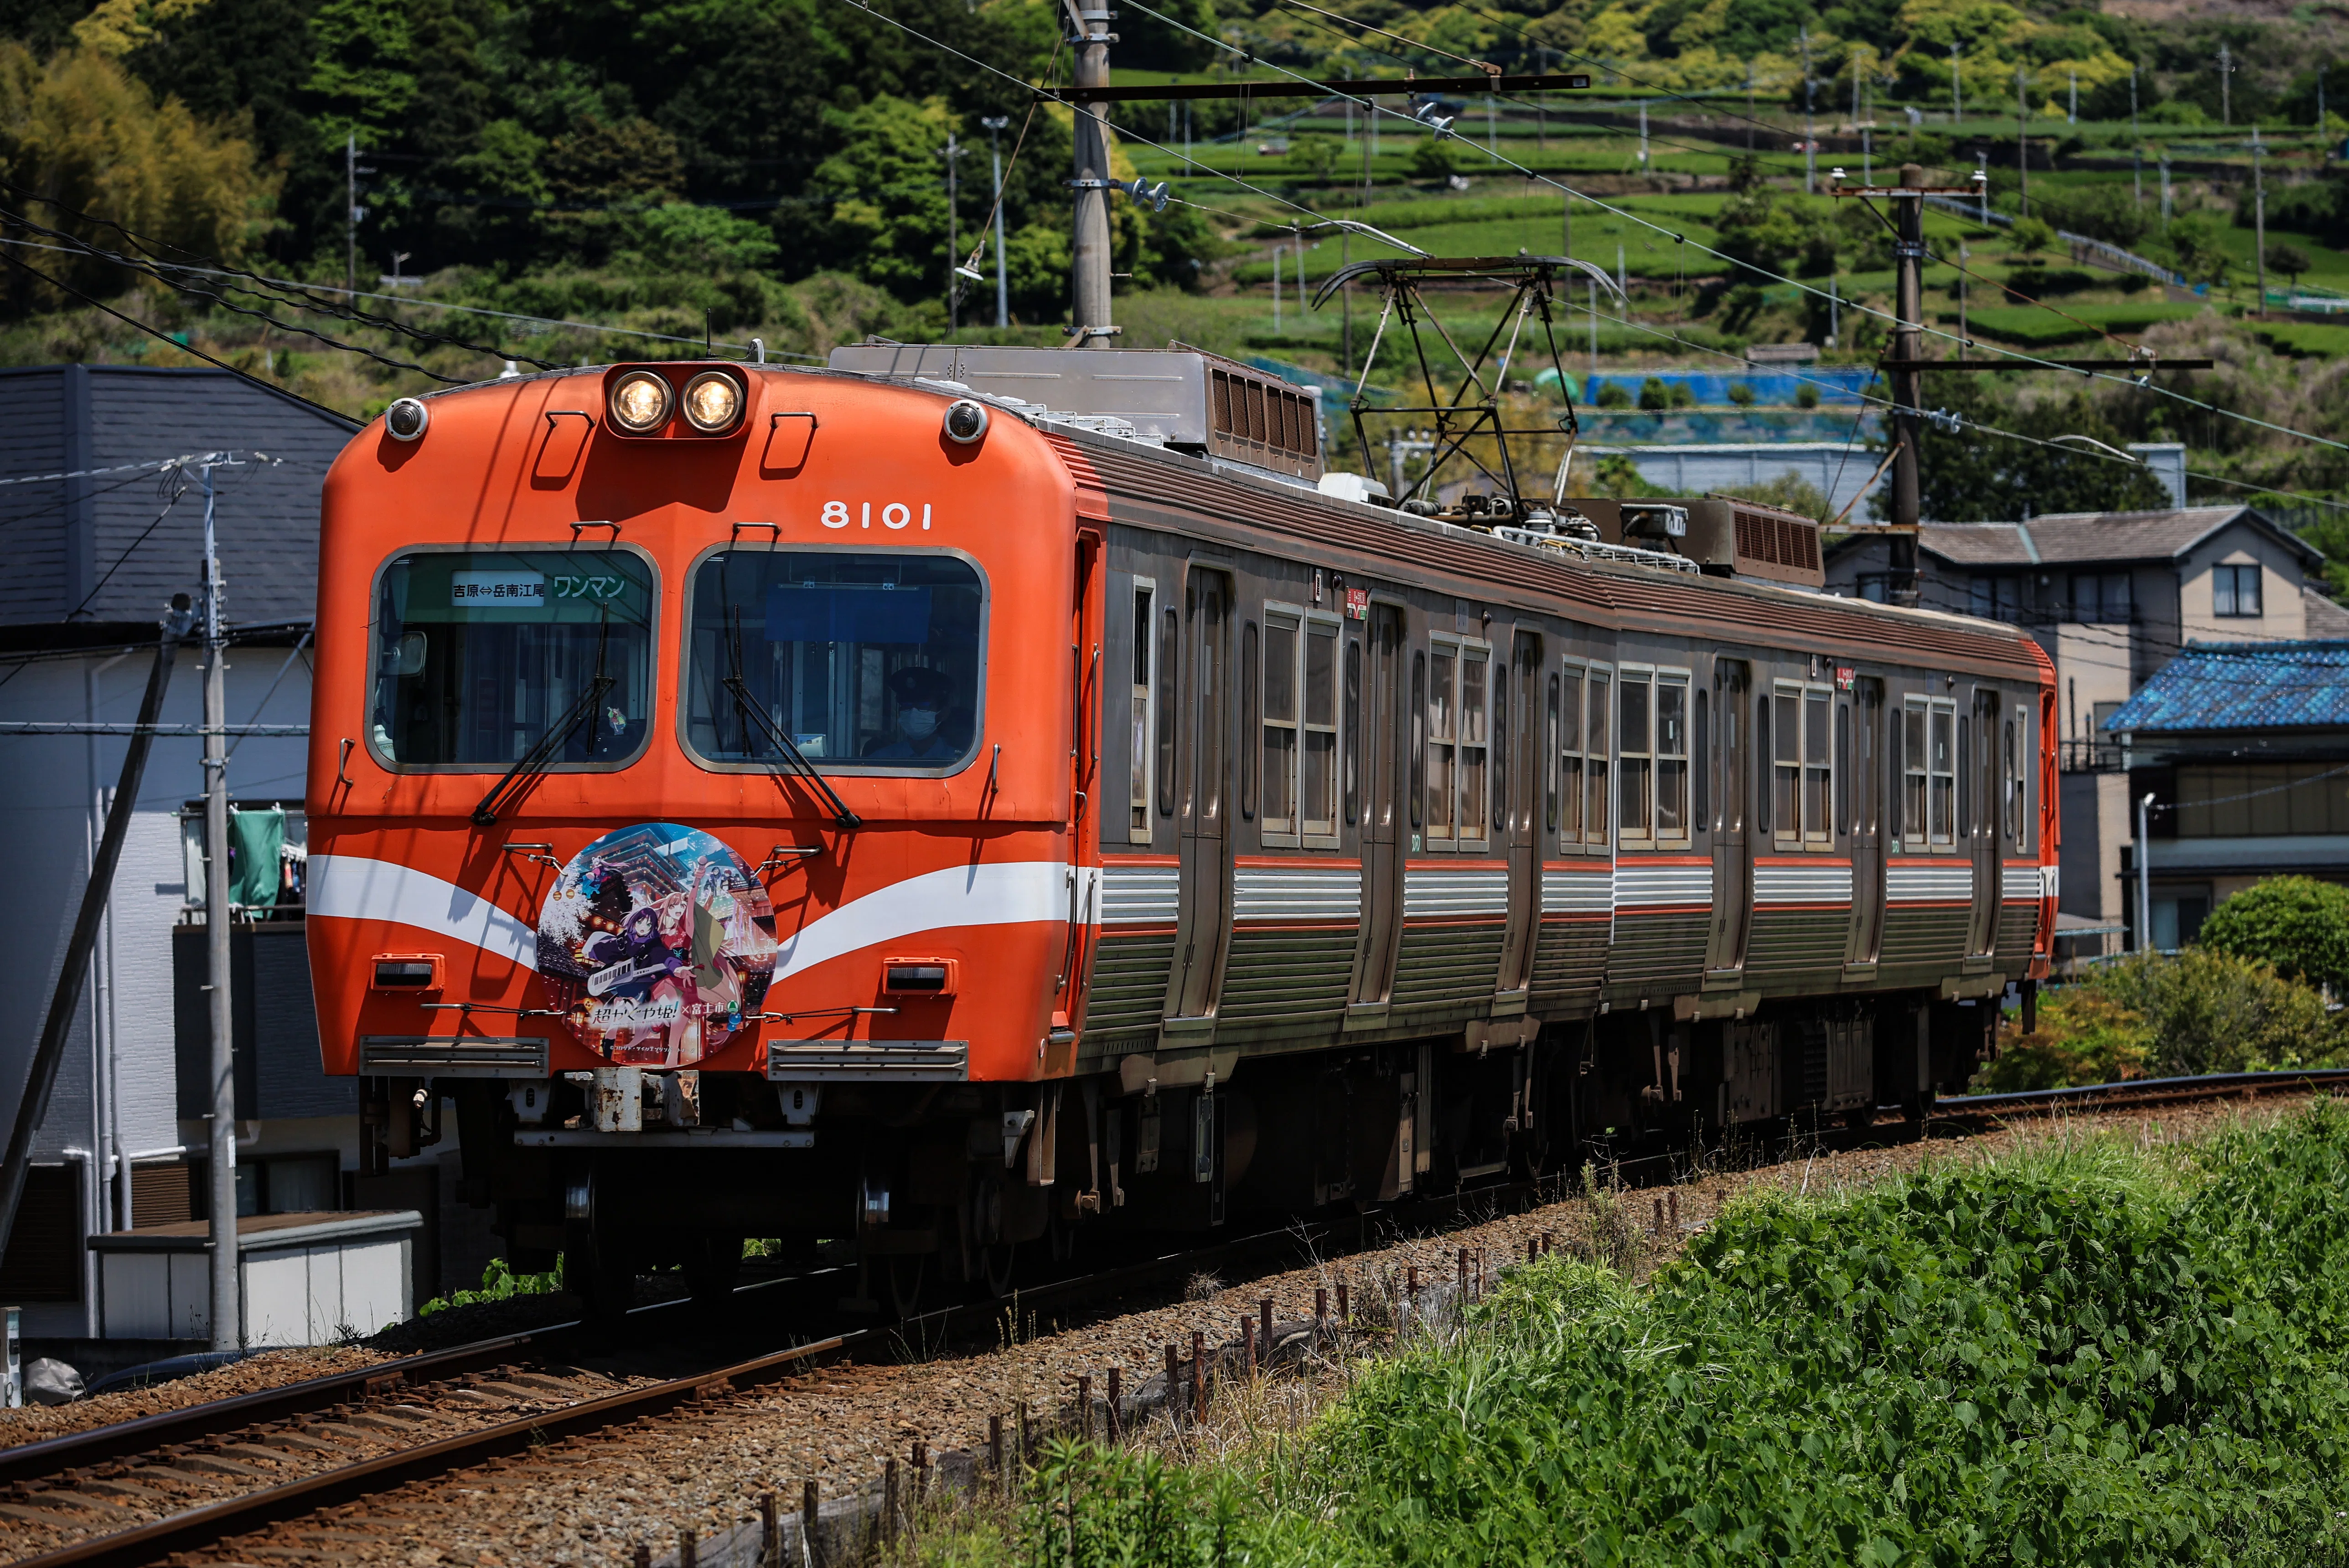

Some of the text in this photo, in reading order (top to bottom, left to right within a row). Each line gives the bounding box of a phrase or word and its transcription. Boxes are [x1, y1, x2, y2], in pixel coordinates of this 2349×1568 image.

[820, 500, 931, 531] 8101
[453, 583, 544, 598] 吉原 岳南江尾
[554, 576, 625, 598] ワンマン
[692, 1001, 724, 1015] 富士市
